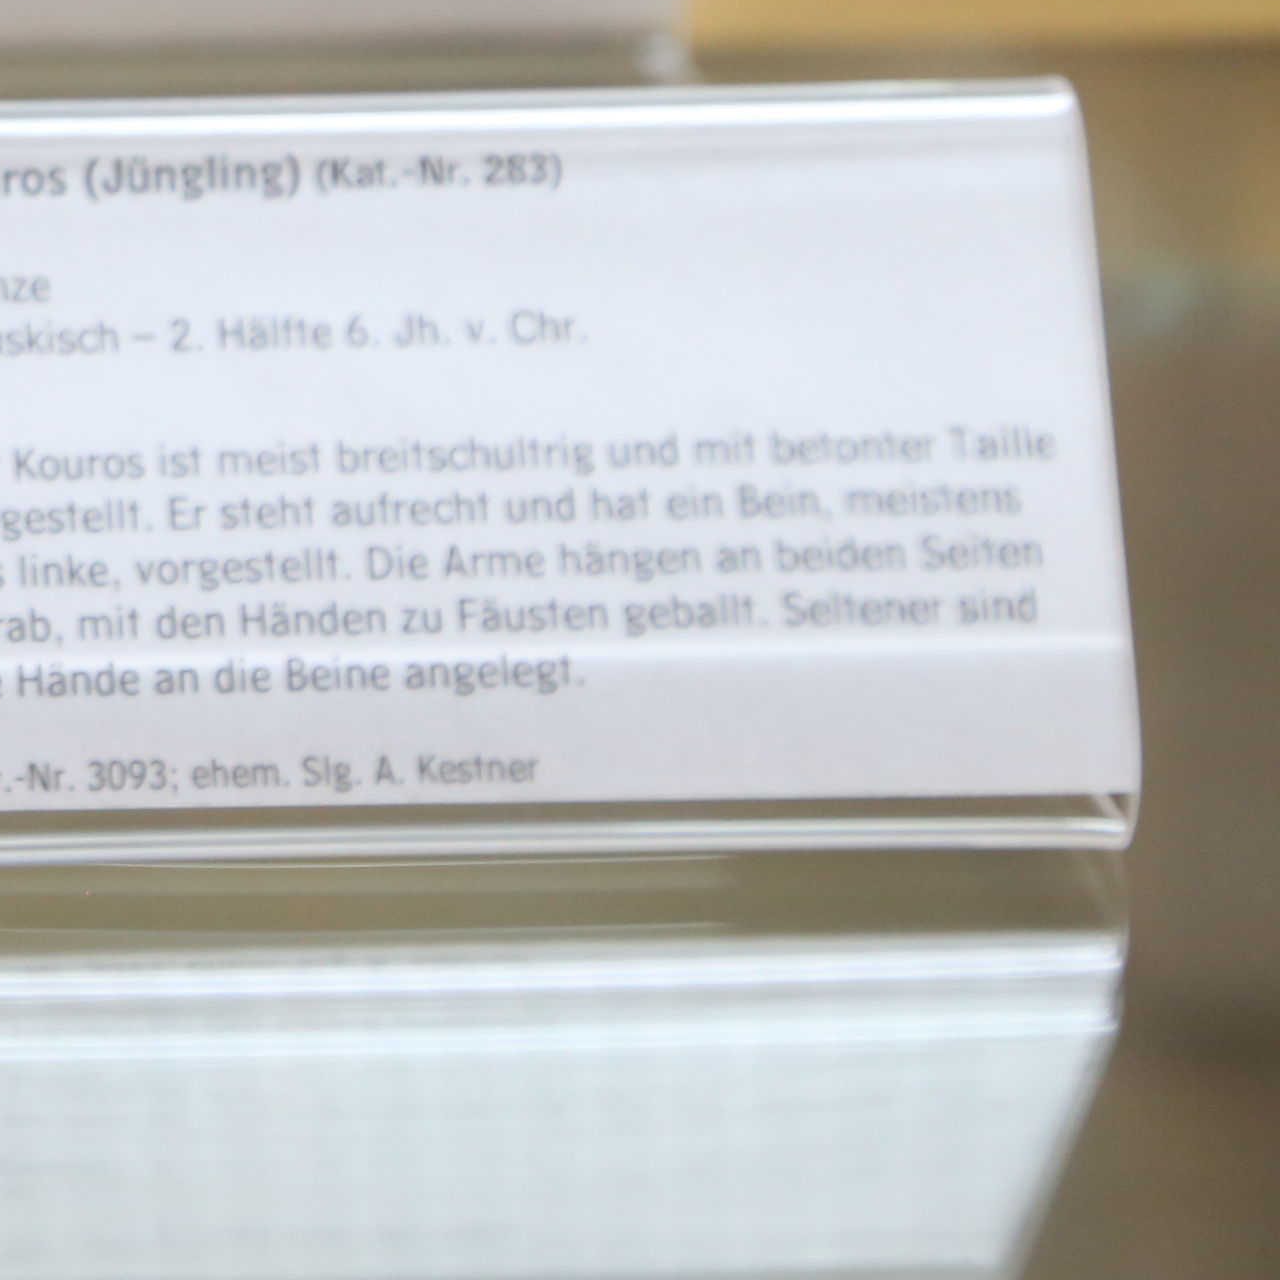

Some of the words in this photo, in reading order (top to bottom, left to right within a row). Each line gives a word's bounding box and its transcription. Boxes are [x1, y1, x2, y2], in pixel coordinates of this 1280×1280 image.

[82, 154, 302, 202] (Jüngling)
[314, 154, 470, 194] (Kat.-Nr.
[482, 152, 564, 190] 283)
[170, 318, 203, 353] 2.
[218, 316, 333, 350] Hälfte
[345, 314, 379, 348] 6.
[393, 311, 450, 348] Jh.
[465, 320, 496, 344] v.
[508, 308, 588, 346] Chr.
[12, 448, 145, 481] Kouros
[156, 444, 201, 478] ist
[216, 442, 321, 477] meist
[337, 435, 595, 476] breitschultrig
[606, 434, 680, 469] und
[692, 432, 756, 465] mit
[770, 430, 936, 466] betonter
[948, 425, 1057, 462] Taille
[167, 496, 206, 531] Er
[220, 494, 316, 530] steht
[331, 490, 490, 528] aufrecht
[504, 488, 576, 524] und
[589, 488, 651, 521] hat
[664, 486, 724, 520] ein
[737, 483, 832, 520] Bein,
[843, 481, 1022, 517] meistens
[18, 554, 120, 592] linke,
[135, 548, 352, 592] vorgestellt.
[366, 545, 429, 581] Die
[444, 543, 546, 578] Arme
[558, 541, 702, 584] hängen
[715, 544, 762, 573] an
[775, 536, 906, 572] beiden
[916, 532, 1044, 570] Seiten
[76, 606, 140, 640] mit
[155, 604, 226, 640] den
[239, 601, 387, 638] Händen
[400, 606, 443, 634] zu
[456, 596, 608, 632] Fäusten
[622, 594, 768, 637] geballt.
[782, 588, 944, 628] Seltener
[957, 587, 1039, 624] sind
[16, 662, 140, 698] Hände
[153, 668, 200, 696] an
[213, 659, 272, 694] die
[284, 657, 391, 692] Beine
[404, 652, 585, 695] angelegt.
[87, 759, 179, 794] 3093;
[190, 758, 290, 790] ehem.
[301, 756, 362, 794] Slg.
[374, 755, 404, 785] A.
[416, 754, 540, 784] Kestner
